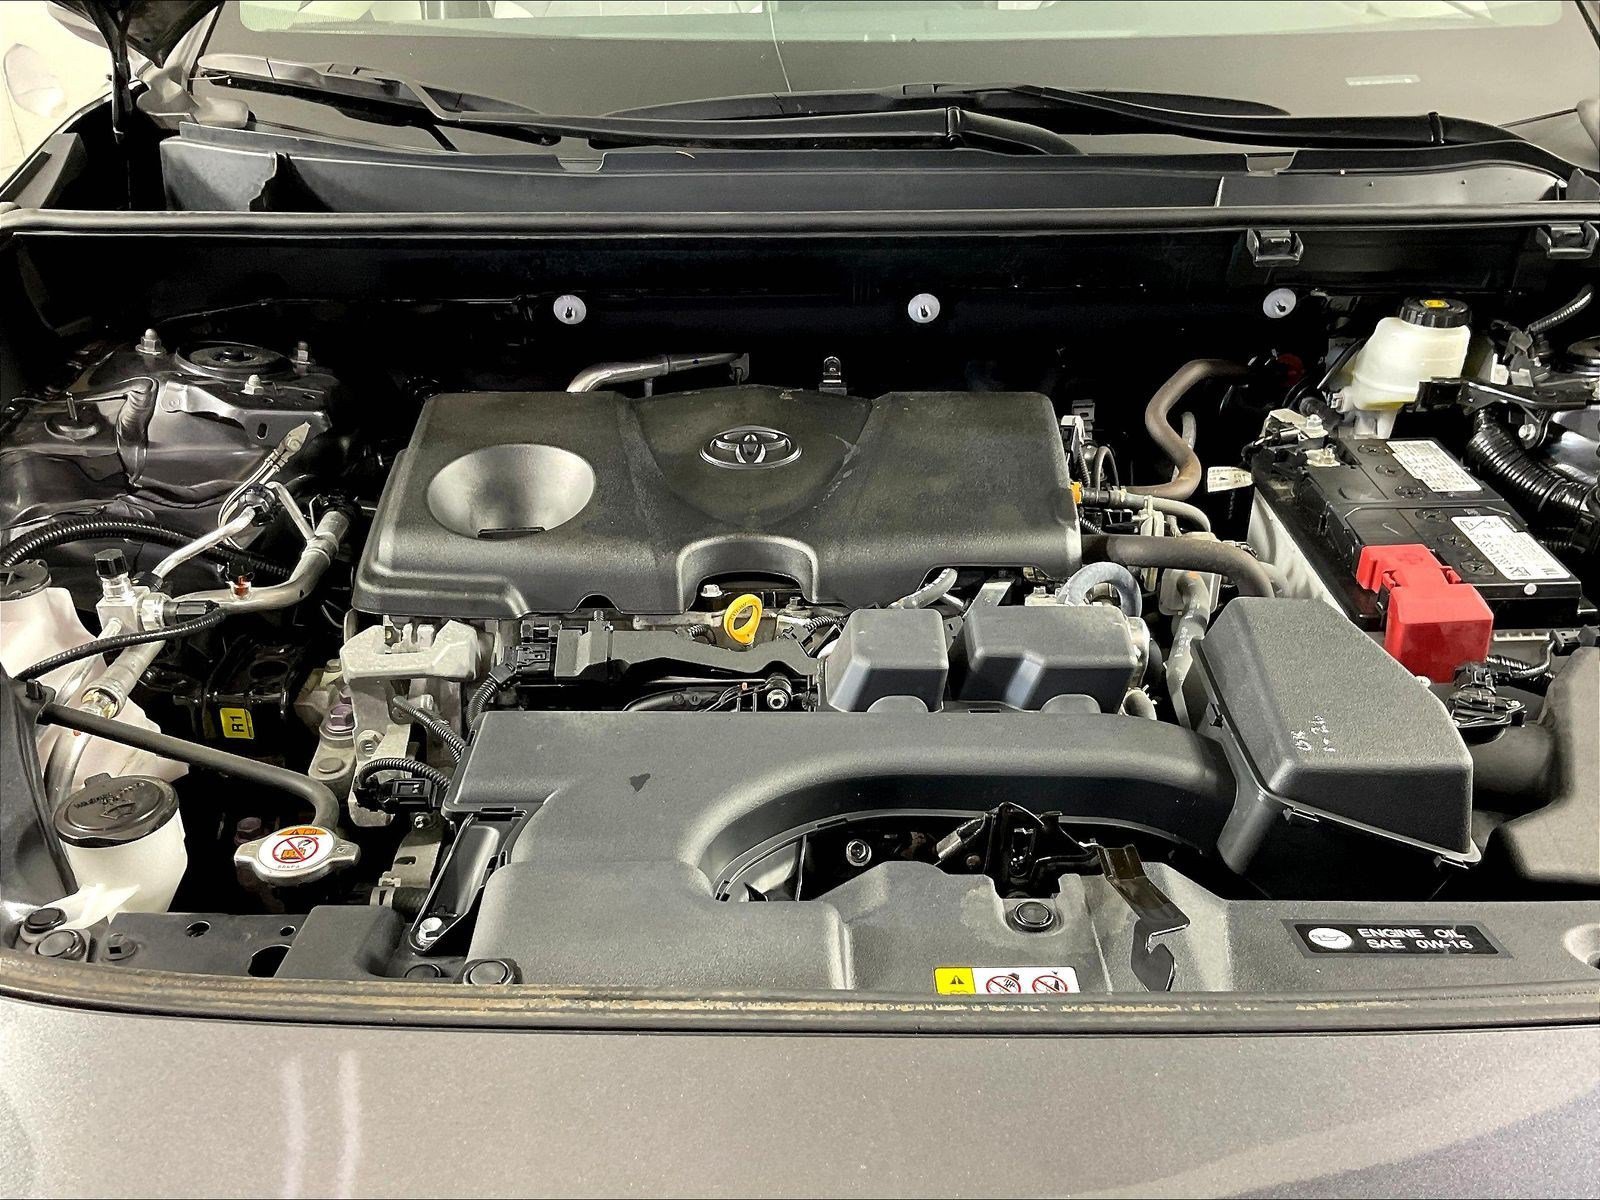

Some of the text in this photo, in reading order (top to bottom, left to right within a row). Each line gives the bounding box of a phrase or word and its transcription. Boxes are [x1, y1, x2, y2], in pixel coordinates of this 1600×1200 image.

[230, 716, 245, 732] R1
[1356, 928, 1466, 938] ENGINE OIL
[1366, 938, 1474, 949] SAE 0W-16
